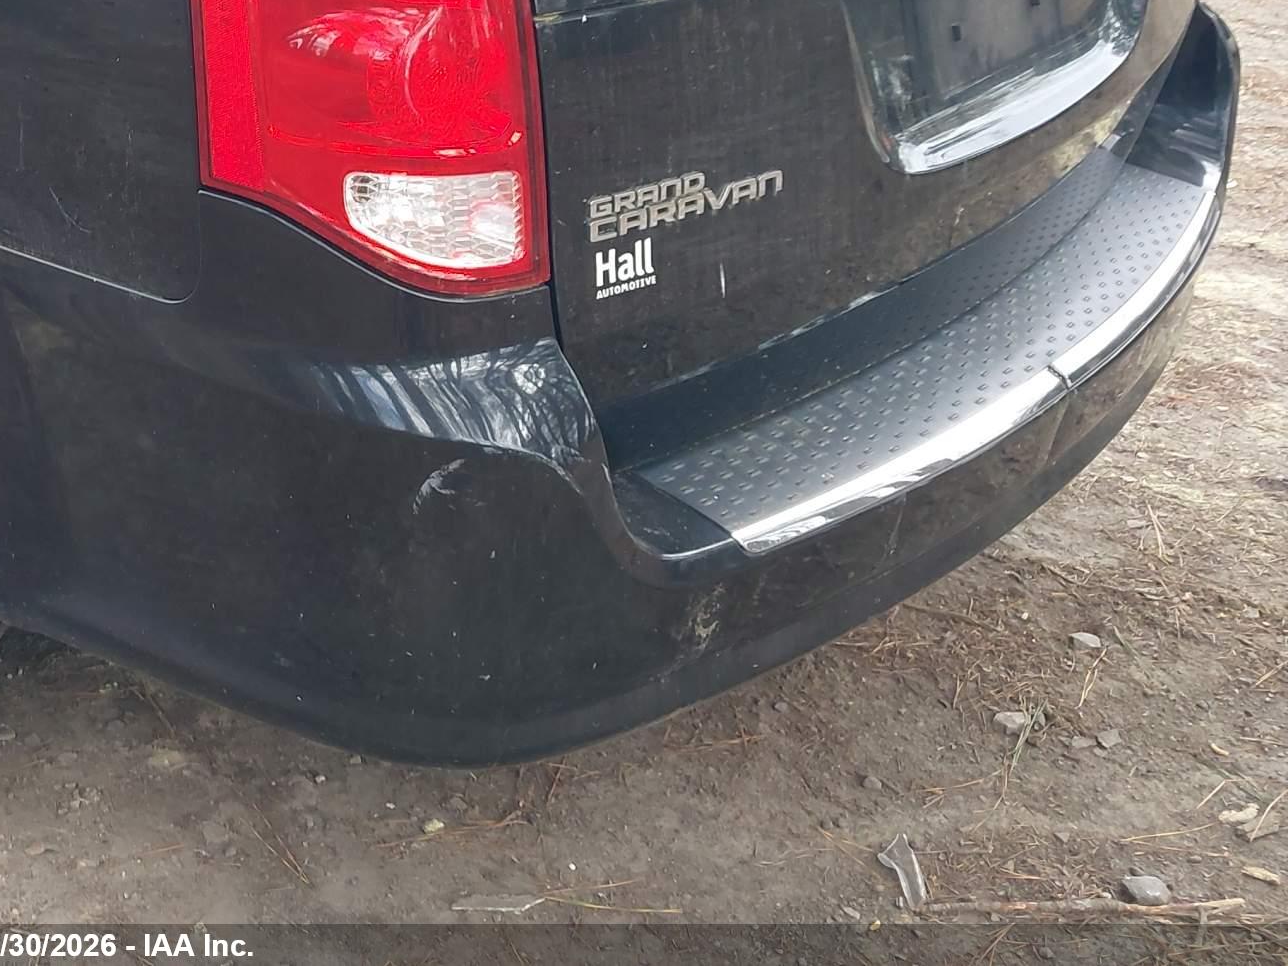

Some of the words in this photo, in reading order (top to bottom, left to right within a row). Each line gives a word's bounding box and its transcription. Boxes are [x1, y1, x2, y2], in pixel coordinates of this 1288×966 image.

[589, 171, 706, 219] GRAND
[589, 169, 784, 243] CARAVAN
[595, 237, 655, 288] Hall
[596, 274, 657, 300] AUTOMOTIVE
